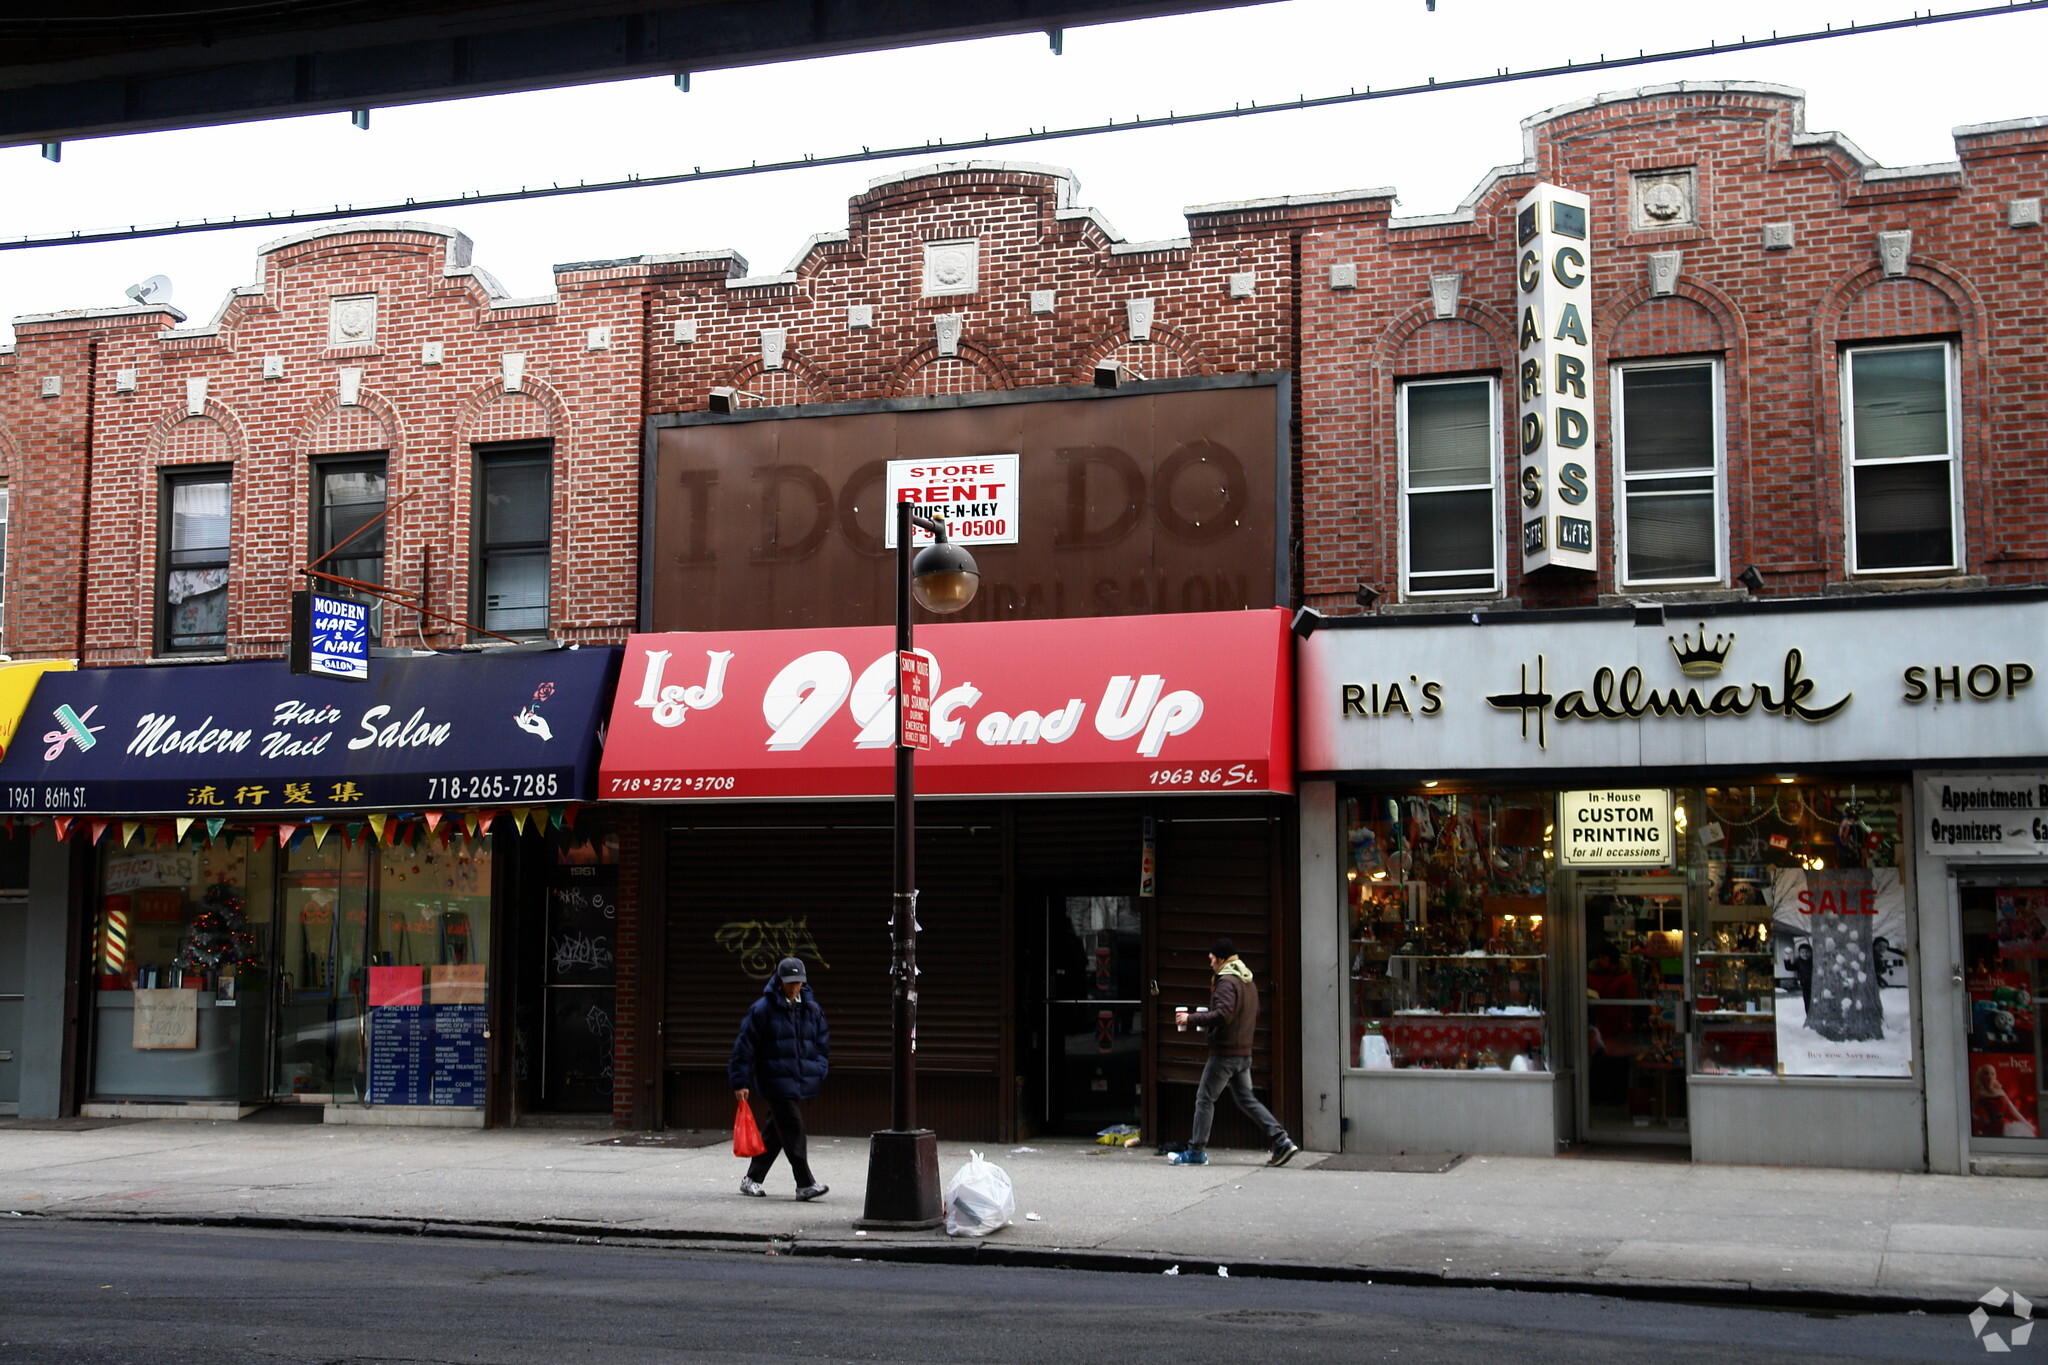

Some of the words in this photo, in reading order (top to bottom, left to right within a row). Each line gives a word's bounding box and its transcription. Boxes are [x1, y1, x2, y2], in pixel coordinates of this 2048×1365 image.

[1519, 249, 1543, 508] CARDS
[1552, 246, 1589, 505] CARDS
[910, 464, 995, 478] STORE
[898, 484, 1006, 504] RENT
[912, 503, 998, 520] OUSE-N-KEY
[315, 598, 365, 620] MODERN
[315, 618, 358, 631] HAIR
[334, 631, 343, 640] &
[324, 641, 363, 653] NAIL
[324, 658, 353, 671] SALON
[902, 658, 916, 673] SNOW
[917, 661, 929, 676] ROUTE
[903, 694, 910, 707] NO
[912, 695, 930, 711] STANDING
[1342, 674, 1443, 717] RIA'S
[1486, 648, 1853, 752] Hallmark
[1904, 663, 2034, 702] SHOP
[272, 700, 341, 726] Hair
[910, 710, 924, 721] DURING
[976, 698, 1086, 745] and
[1095, 674, 1204, 757] Up
[126, 712, 251, 758] Modern
[347, 704, 451, 750] Salon
[905, 720, 927, 732] EMERGENCY
[260, 731, 333, 759] Nail
[1150, 769, 1193, 785] 1963
[1199, 769, 1221, 784] 86
[1222, 764, 1259, 787] St.
[187, 781, 364, 805] 流行髮集
[429, 773, 558, 799] 718-265-7285
[9, 787, 36, 807] 1961
[45, 787, 70, 807] 86th
[73, 787, 87, 807] ST.
[1942, 785, 2033, 812] Appointment
[1578, 808, 1654, 822] CUSTOM
[1573, 828, 1660, 842] PRINTING
[1932, 818, 2002, 845] Organizers
[1572, 847, 1587, 857] for
[1590, 847, 1603, 857] all
[1606, 847, 1661, 857] occassions
[570, 866, 596, 876] 1961
[1797, 889, 1879, 915] SALE
[2010, 1056, 2029, 1068] her
